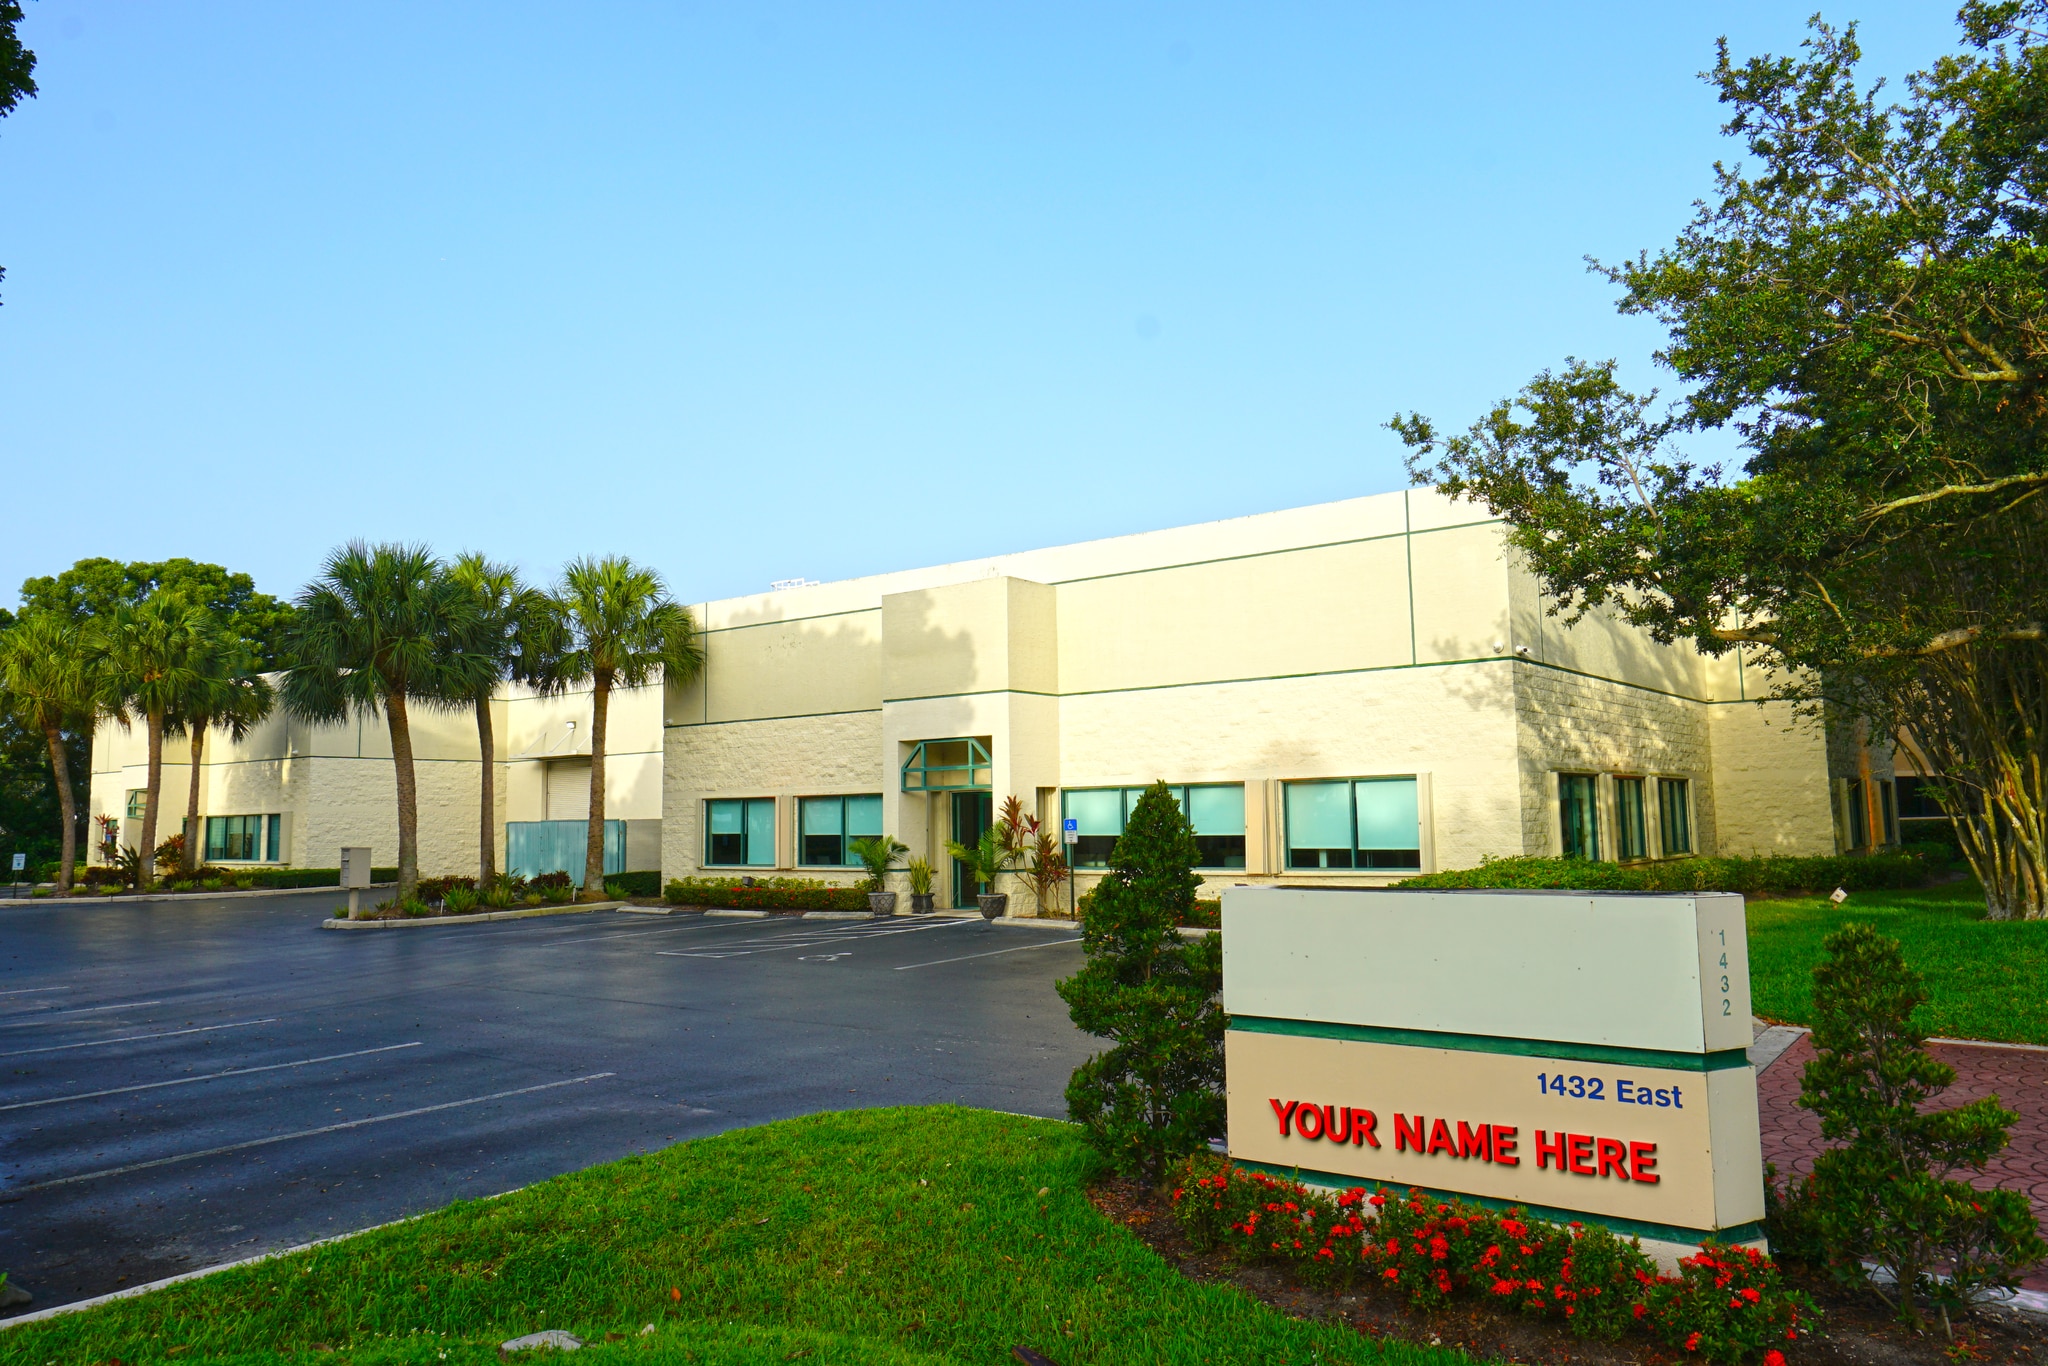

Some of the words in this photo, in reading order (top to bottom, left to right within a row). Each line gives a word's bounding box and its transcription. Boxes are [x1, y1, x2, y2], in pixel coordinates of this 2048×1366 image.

[1537, 1072, 1605, 1100] 1432
[1616, 1079, 1683, 1109] East
[1269, 1098, 1381, 1148] YOUR
[1394, 1113, 1520, 1165] NAME
[1535, 1129, 1660, 1184] HERE
